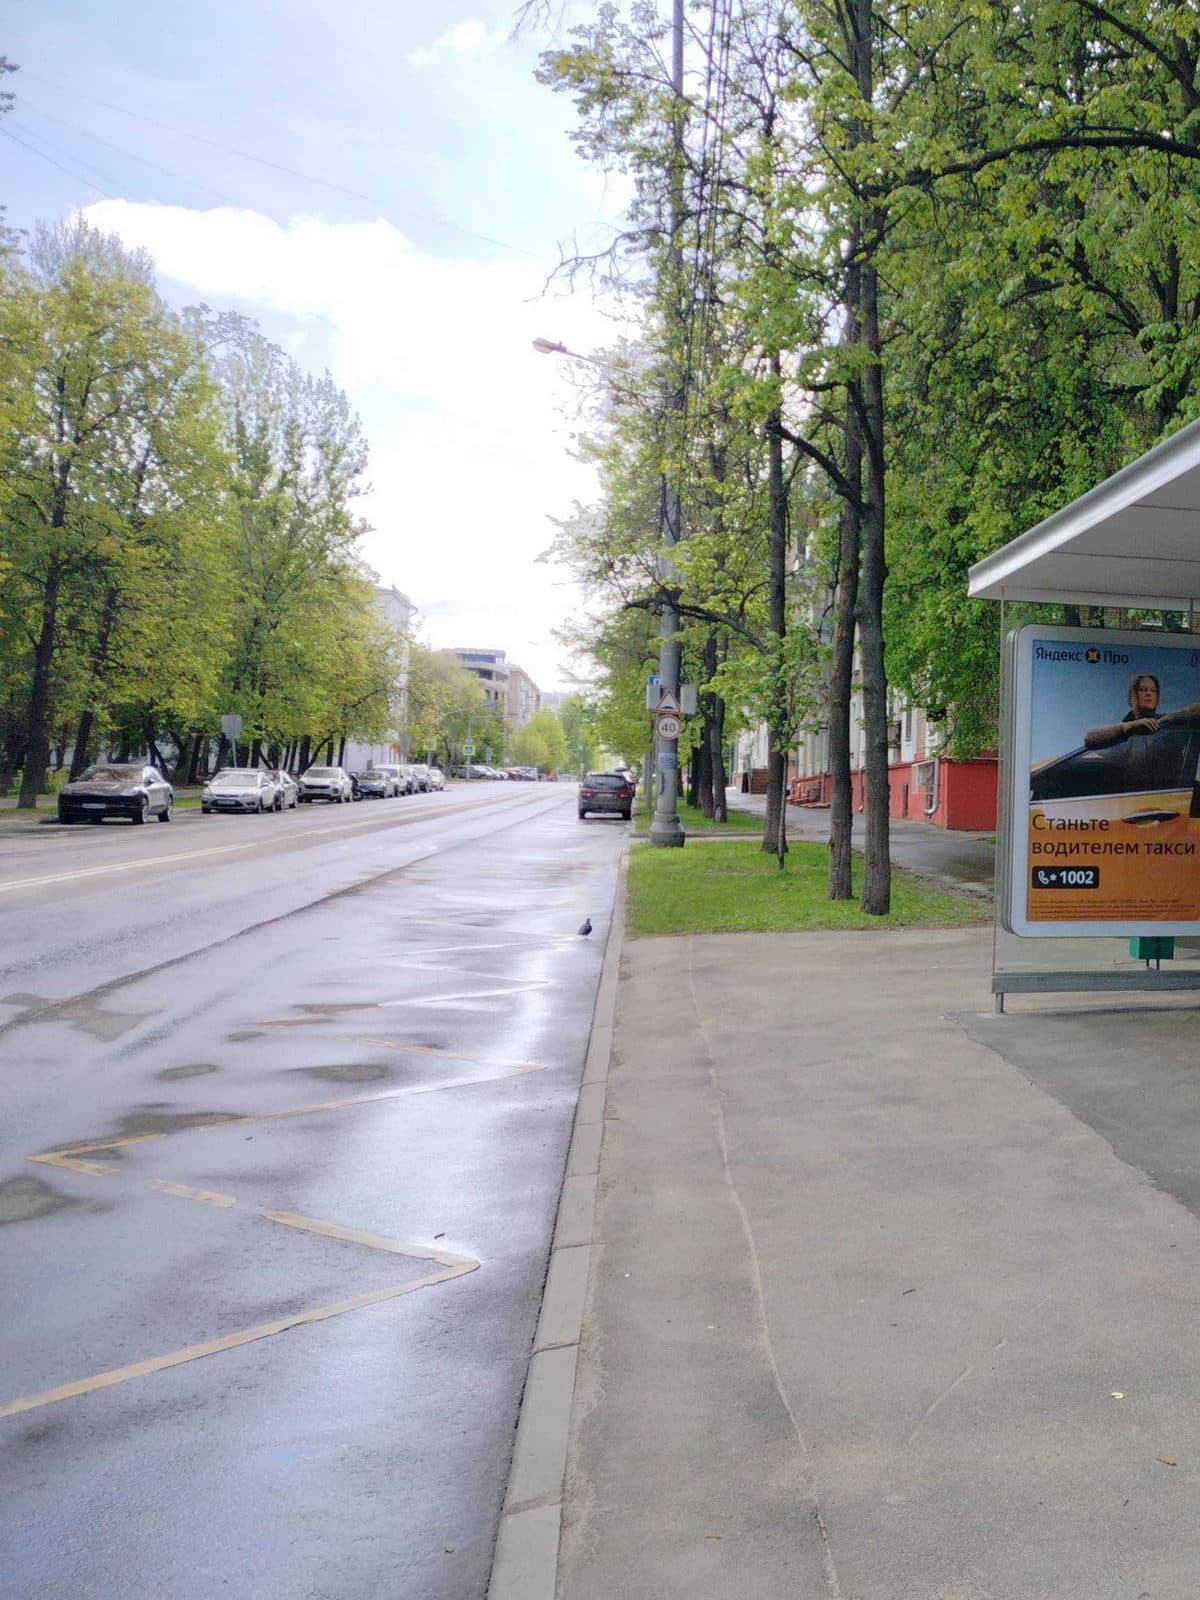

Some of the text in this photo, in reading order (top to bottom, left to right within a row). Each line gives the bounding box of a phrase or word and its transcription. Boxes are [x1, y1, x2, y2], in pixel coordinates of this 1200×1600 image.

[1035, 647, 1129, 665] Яндекс Про
[661, 722, 676, 733] 40
[1032, 814, 1110, 831] Станьте
[1032, 841, 1195, 857] водителем такси
